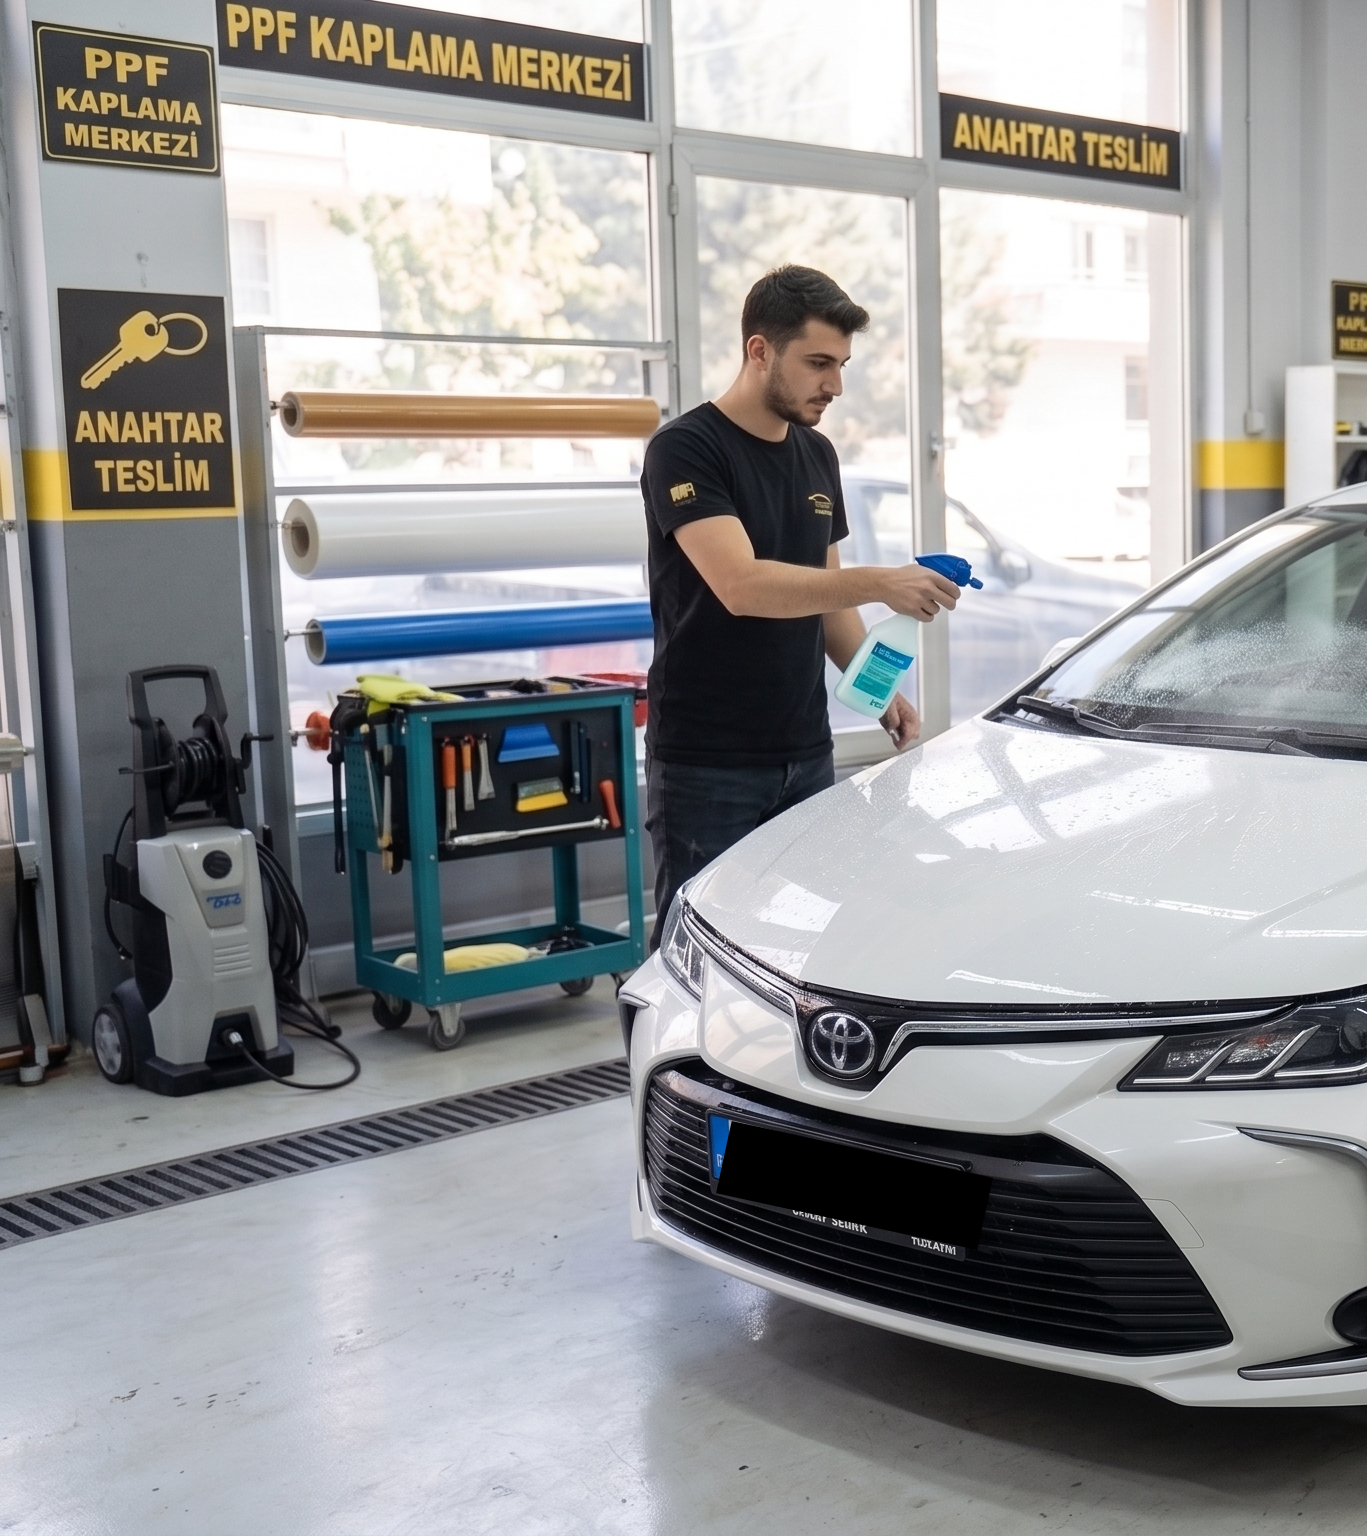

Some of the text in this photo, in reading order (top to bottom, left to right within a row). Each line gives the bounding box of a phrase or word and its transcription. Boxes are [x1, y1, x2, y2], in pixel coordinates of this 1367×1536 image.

[84, 46, 169, 87] PPF
[226, 3, 632, 102] PPF KAPLAMA MERKEZİ
[56, 86, 202, 125] KAPLAMA
[64, 122, 199, 159] MERKEZİ
[953, 112, 1169, 176] ANAHTAR TESLİM
[75, 410, 225, 444] ANAHTAR
[94, 451, 210, 493] TESLİM
